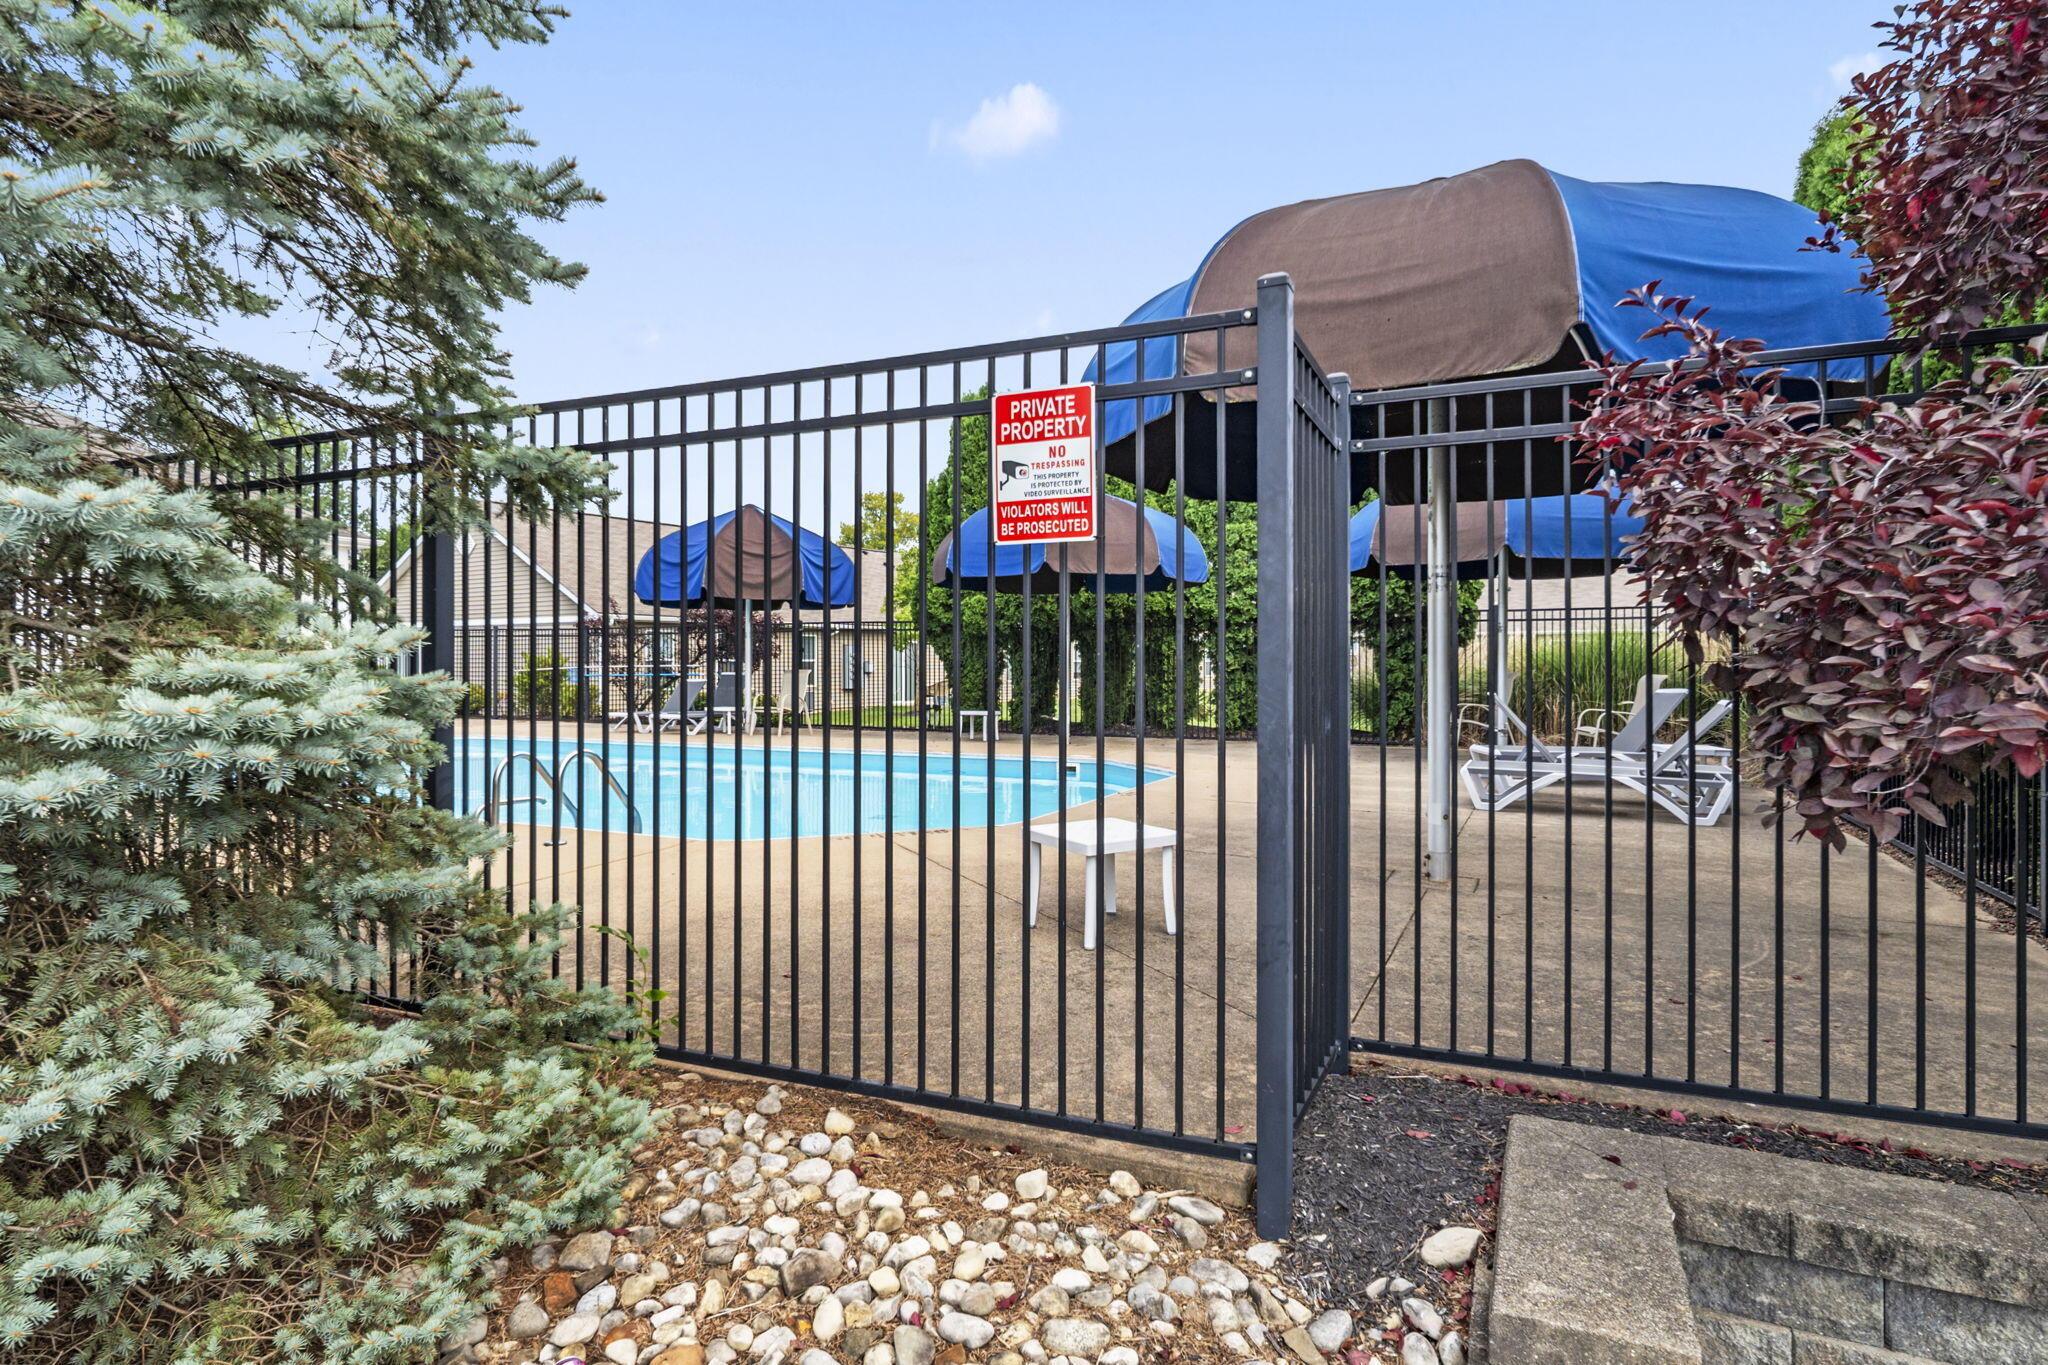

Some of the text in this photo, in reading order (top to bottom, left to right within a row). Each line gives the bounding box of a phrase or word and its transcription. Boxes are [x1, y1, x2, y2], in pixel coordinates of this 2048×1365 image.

[1010, 394, 1076, 420] PRIVATE
[1000, 415, 1087, 442] PROPERTY
[1049, 445, 1066, 458] NO
[1031, 458, 1086, 470] TRESPASSING
[1048, 472, 1079, 480] PROPERTY
[1037, 480, 1073, 488] PROTECTED
[1024, 487, 1090, 498] VIDEO SURVEILLANCE
[1000, 501, 1087, 518] VIOLATORS WILL
[1001, 518, 1089, 536] BE PROSECUTED
